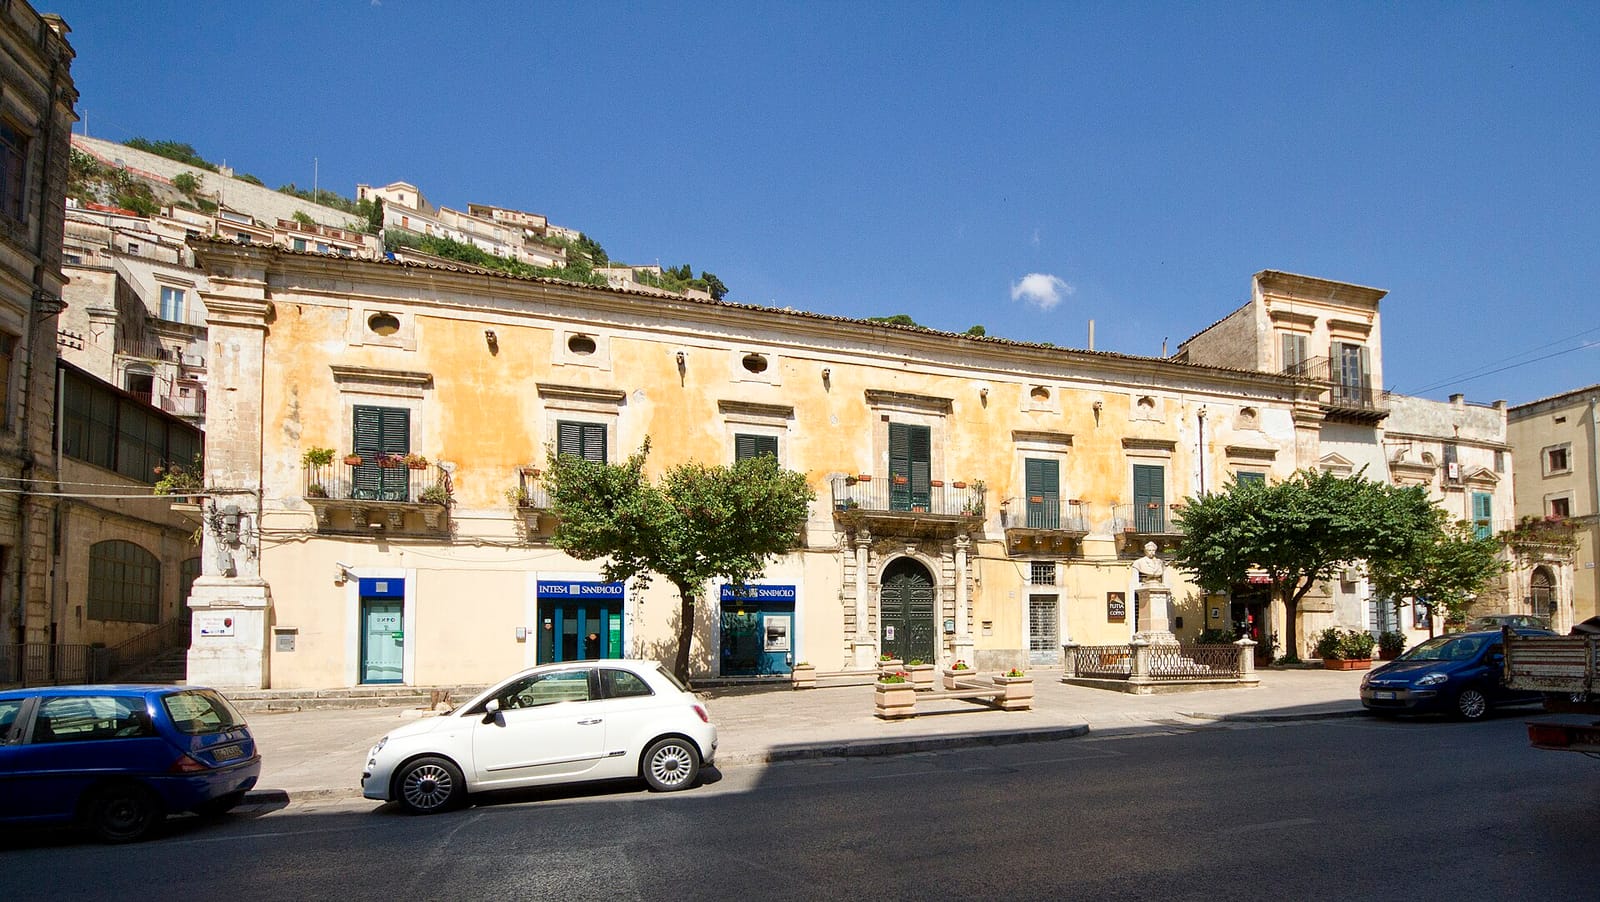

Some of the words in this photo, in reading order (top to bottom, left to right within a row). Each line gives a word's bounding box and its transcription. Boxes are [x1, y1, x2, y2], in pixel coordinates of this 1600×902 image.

[539, 585, 568, 594] INTESA
[581, 585, 622, 594] SANPAOLO
[759, 589, 794, 597] SANPAOLO
